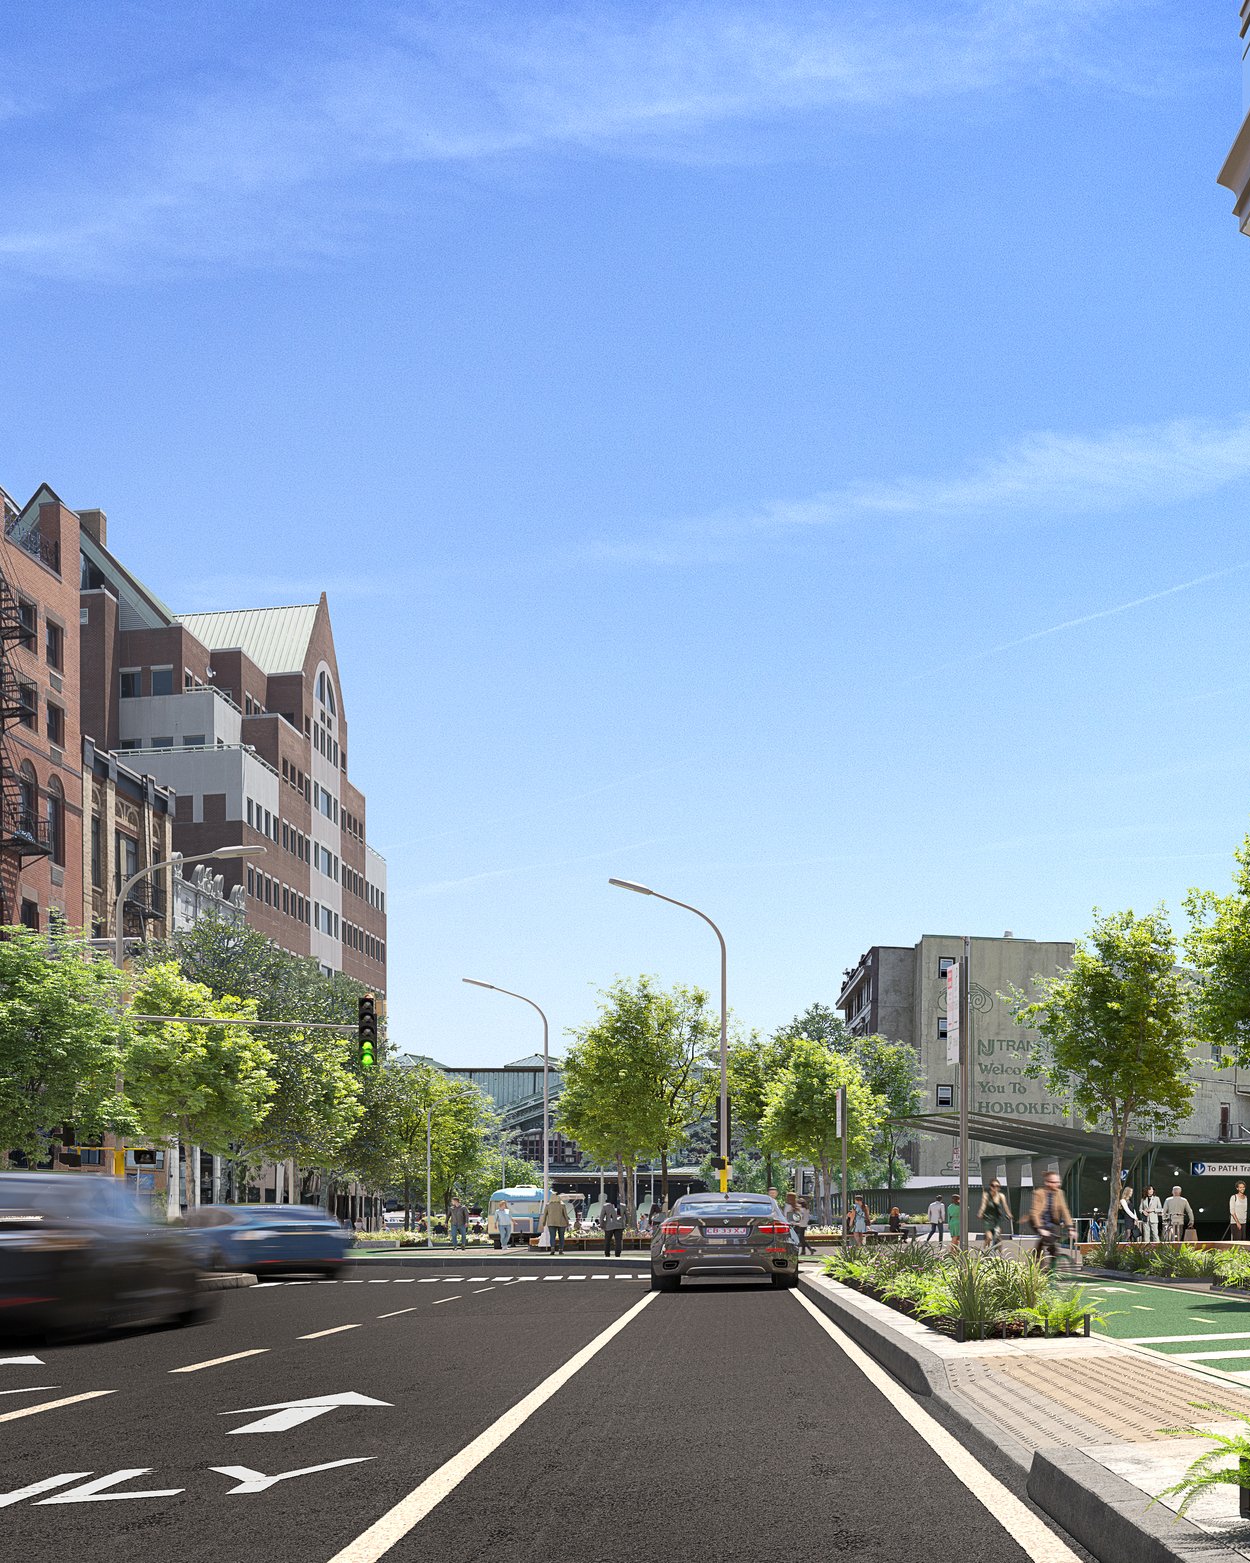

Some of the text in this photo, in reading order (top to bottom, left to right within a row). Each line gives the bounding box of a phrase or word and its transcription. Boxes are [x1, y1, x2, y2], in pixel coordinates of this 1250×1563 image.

[978, 1039, 995, 1056] NJ
[978, 1081, 1027, 1094] You To
